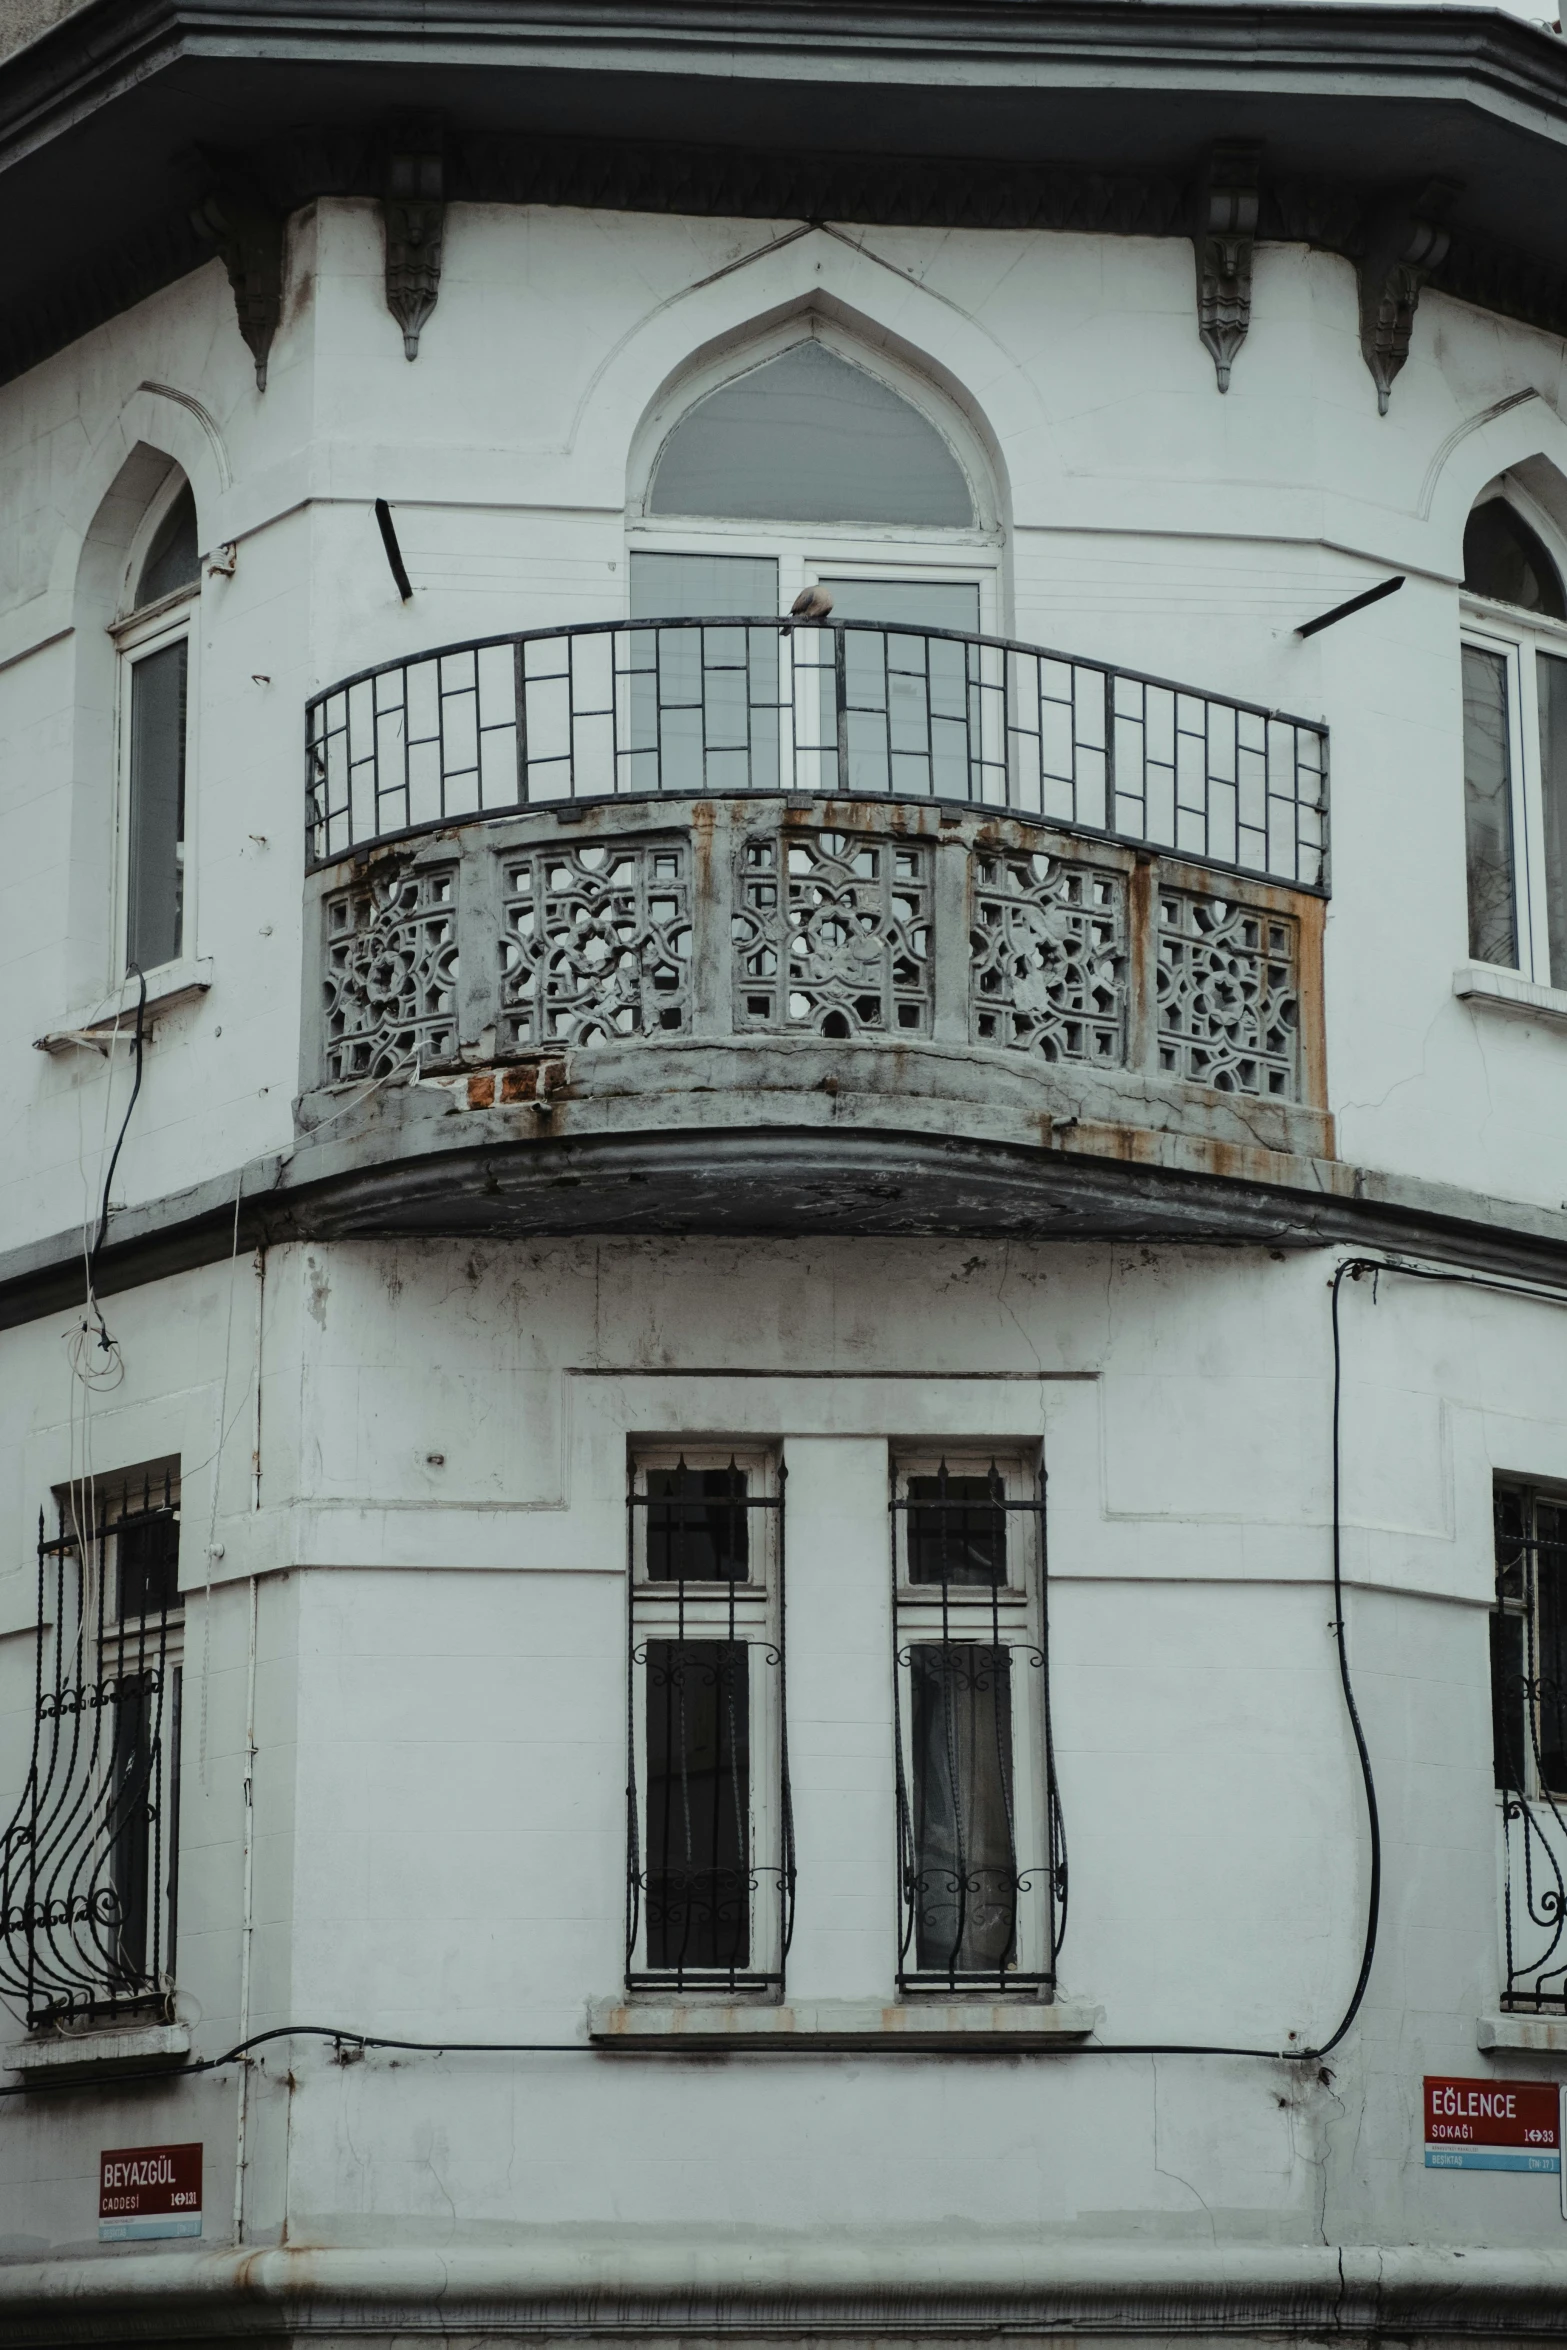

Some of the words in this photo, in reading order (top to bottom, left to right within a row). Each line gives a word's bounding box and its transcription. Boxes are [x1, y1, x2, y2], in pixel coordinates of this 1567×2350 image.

[1432, 2087, 1517, 2118] EĞLENCE
[1432, 2124, 1473, 2139] SOKAĞI
[1432, 2154, 1463, 2166] BEŞİKTAŞ
[104, 2155, 176, 2188] BEYAZGÜL
[102, 2194, 139, 2210] CADDESİ
